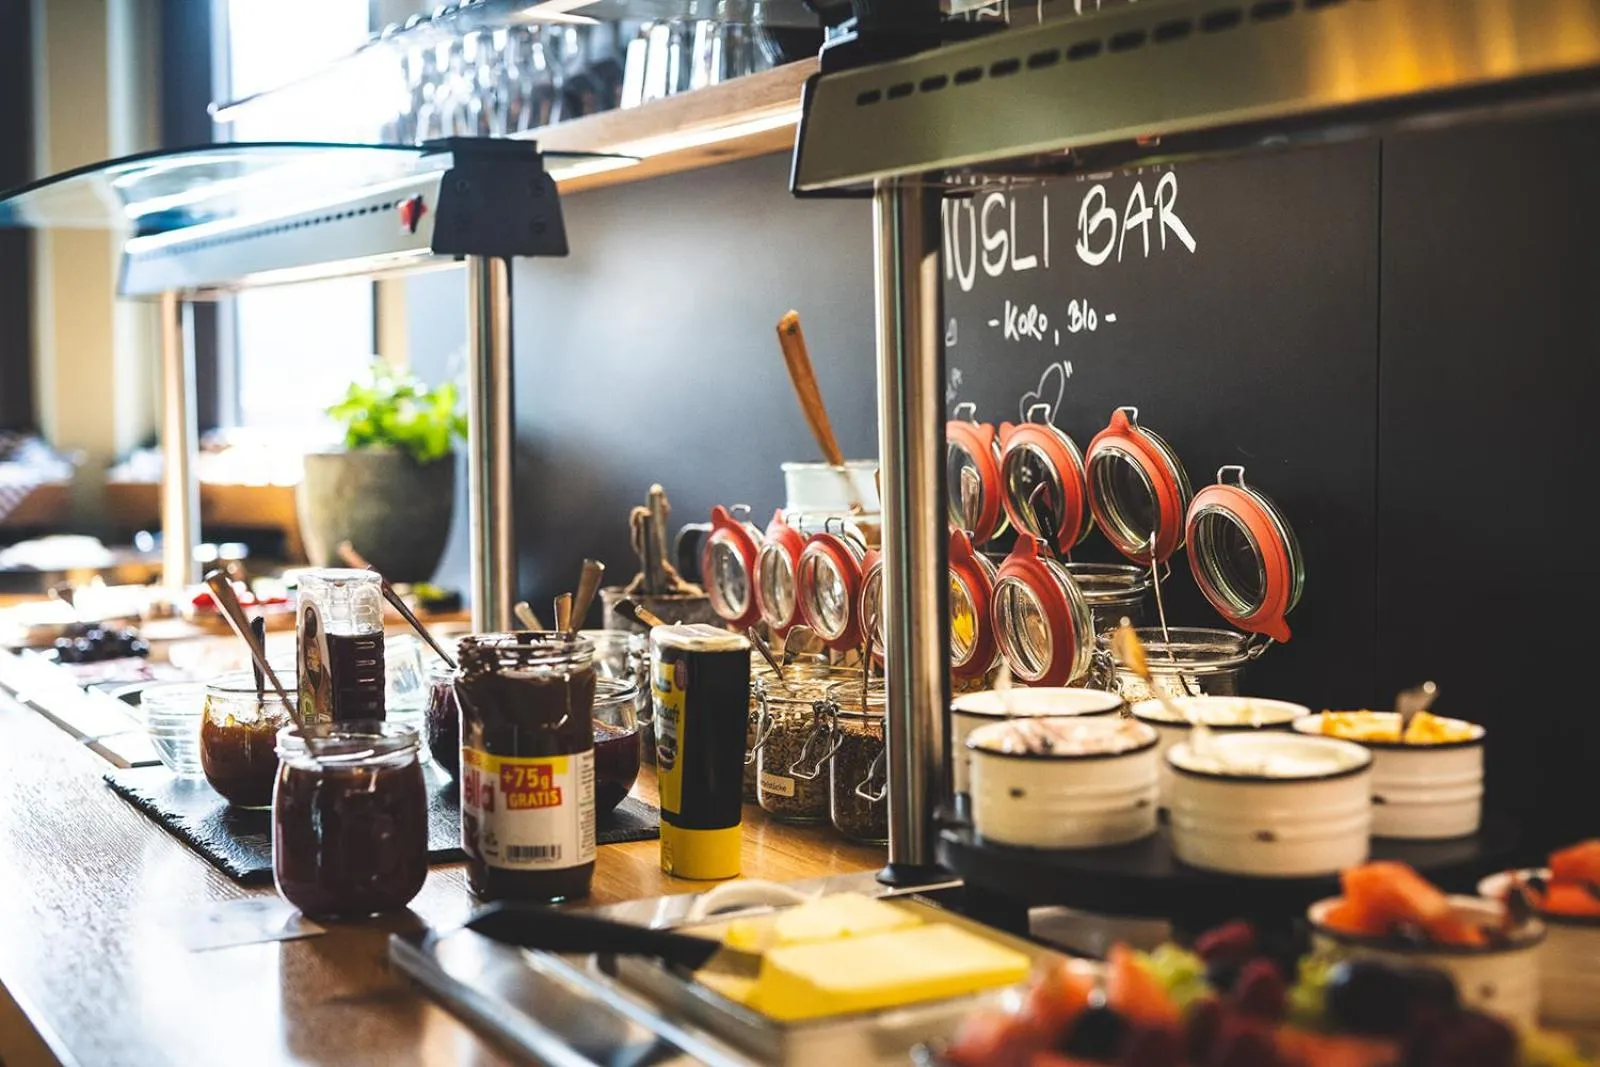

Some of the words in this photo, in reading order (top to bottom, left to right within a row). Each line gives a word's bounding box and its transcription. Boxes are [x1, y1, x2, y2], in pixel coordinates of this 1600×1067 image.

[1075, 171, 1196, 266] BAR
[503, 767, 551, 790] +75g
[509, 789, 559, 809] GRATIS
